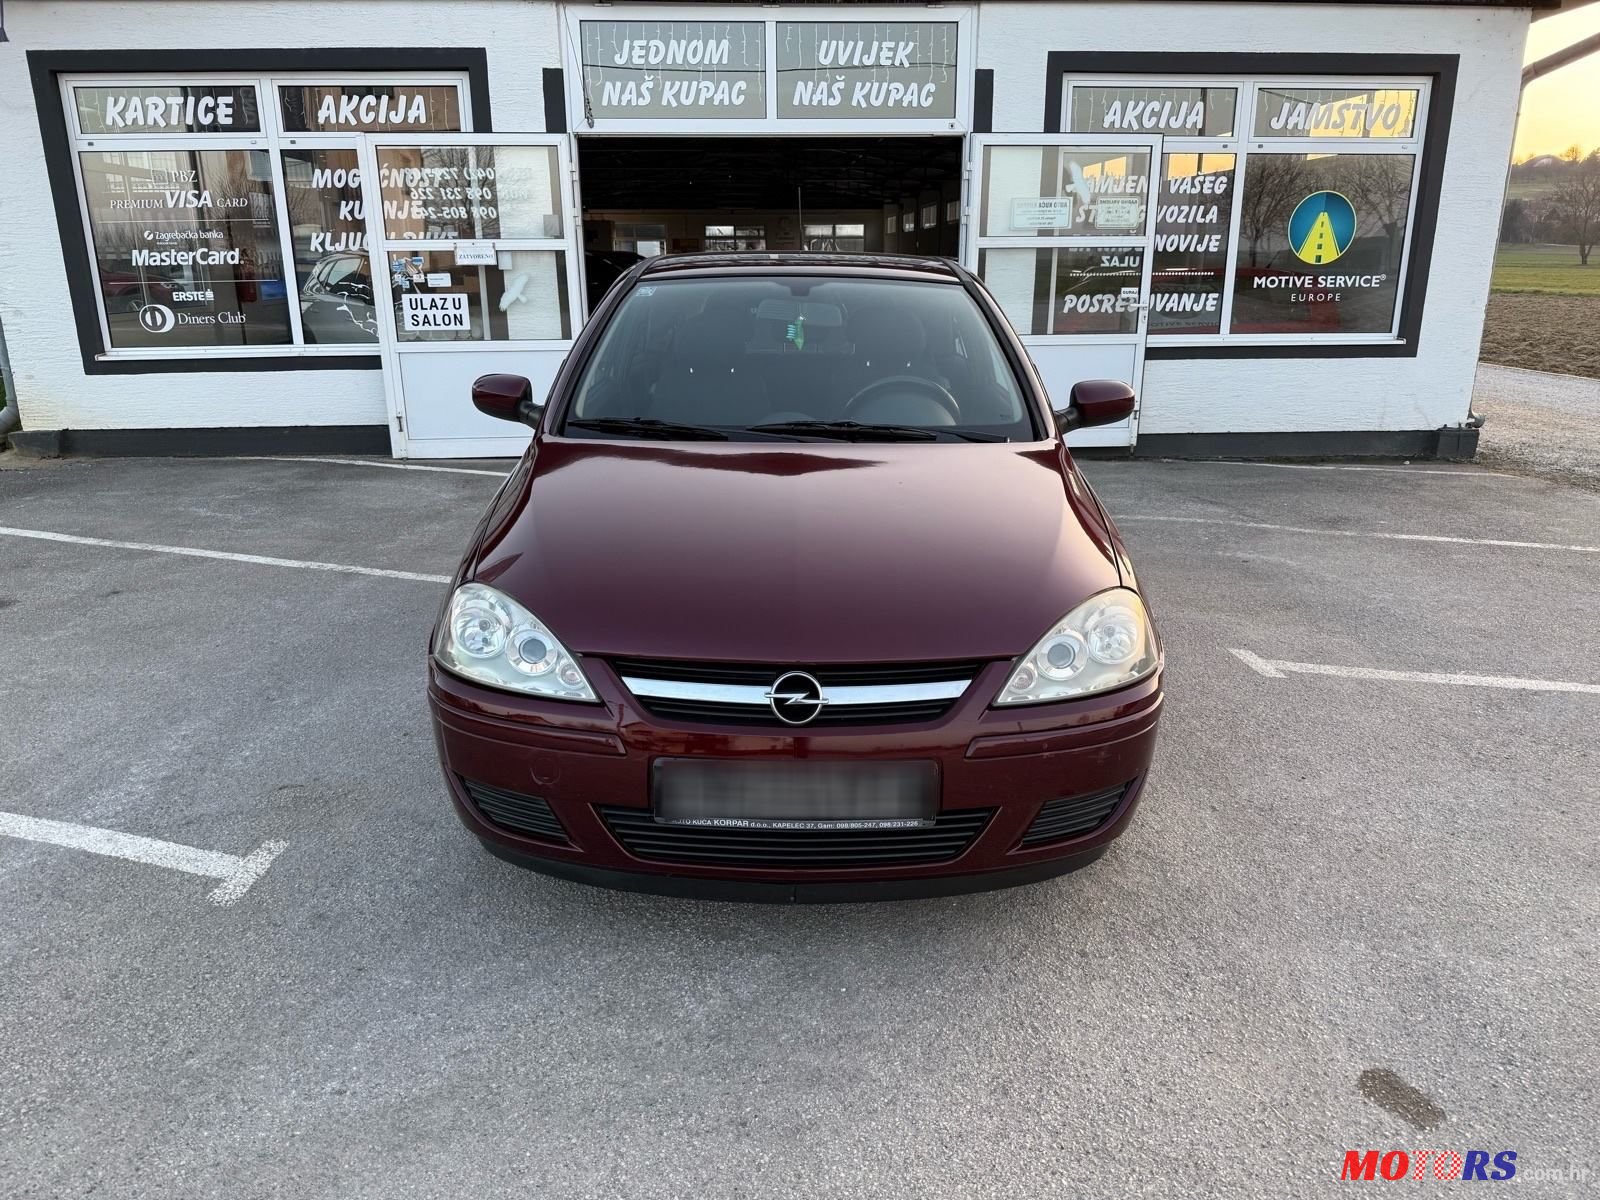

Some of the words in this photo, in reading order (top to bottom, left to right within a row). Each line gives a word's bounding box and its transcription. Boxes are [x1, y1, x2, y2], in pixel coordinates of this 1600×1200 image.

[614, 39, 730, 65] JEDNOM
[818, 40, 915, 68] UVIJEK
[602, 75, 655, 106] NAŠ
[661, 81, 747, 108] KUPAC
[793, 75, 845, 107] NAŠ
[851, 82, 935, 109] KUPAC
[105, 96, 234, 128] KARTICE
[318, 94, 427, 126] AKCIJA
[1103, 101, 1204, 131] AKCIJA
[1270, 102, 1401, 131] JAMSTVO
[171, 170, 198, 183] PBZ
[312, 163, 442, 189] MOGĆNOST
[1169, 171, 1228, 194] VAŠEG
[110, 200, 163, 209] PREMIUM
[164, 190, 213, 208] VISA
[217, 198, 248, 207] CARD
[339, 200, 423, 221] KUNJE
[1157, 205, 1218, 224] VOZILA
[155, 231, 198, 242] Zagrebačka
[199, 230, 224, 239] banka
[1154, 234, 1221, 253] NOVIJE
[1253, 276, 1313, 289] MOTIVE
[172, 291, 205, 302] ERSTE
[409, 298, 448, 310] ULAZ
[452, 298, 462, 310] U
[1291, 293, 1341, 302] EUROPE
[177, 312, 216, 325] Diners
[411, 314, 464, 326] SALON
[713, 819, 749, 828] KORPAR
